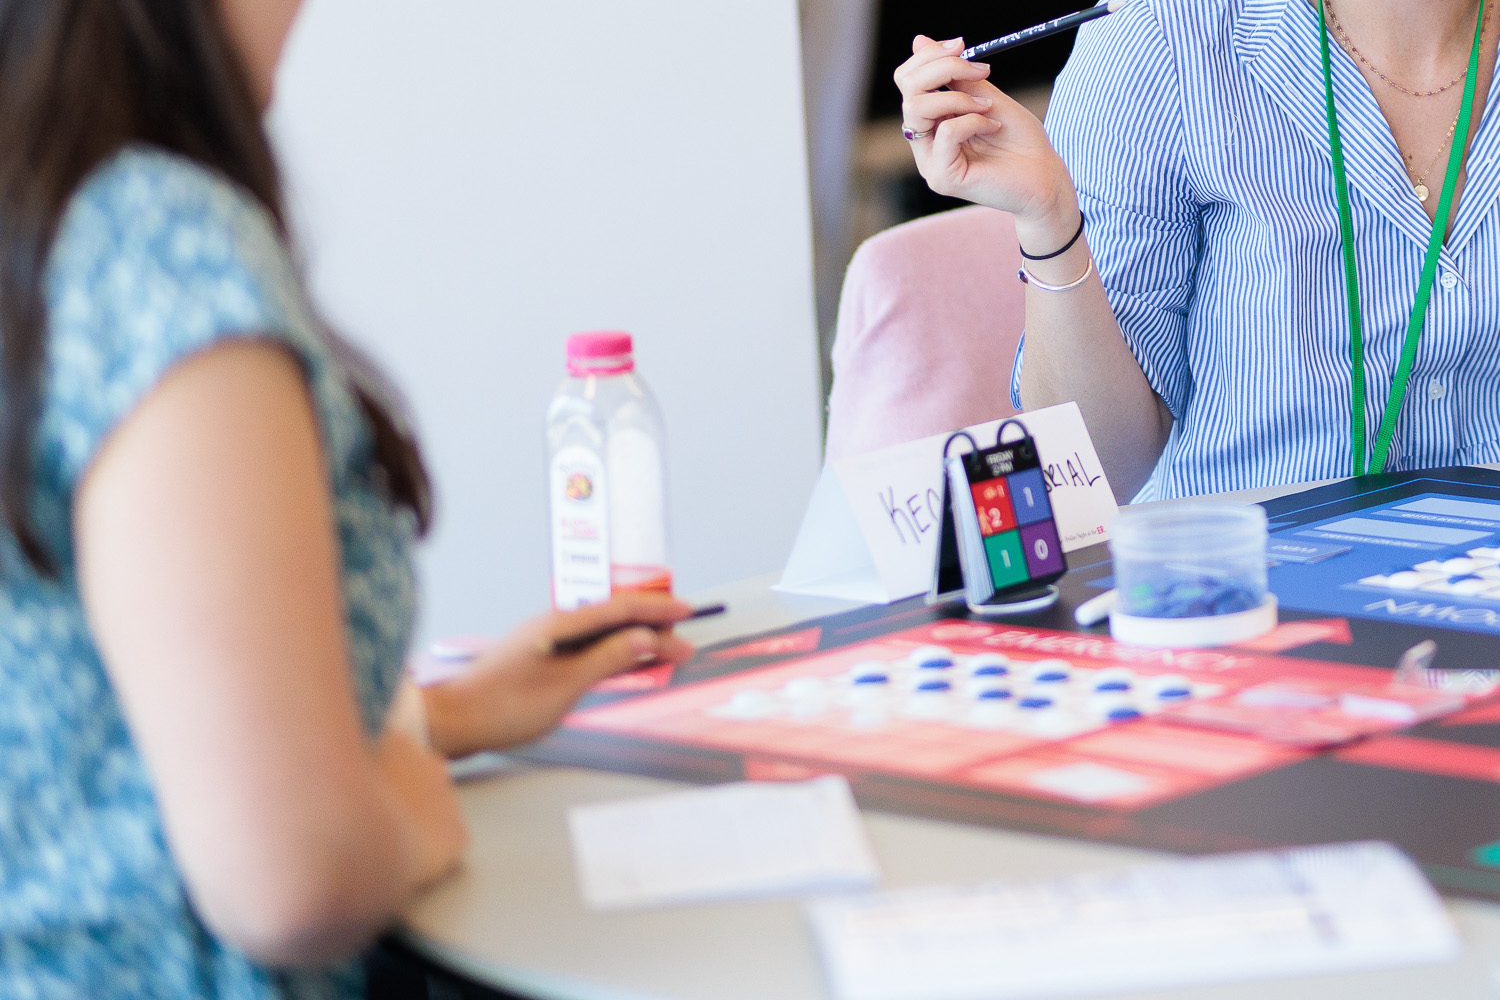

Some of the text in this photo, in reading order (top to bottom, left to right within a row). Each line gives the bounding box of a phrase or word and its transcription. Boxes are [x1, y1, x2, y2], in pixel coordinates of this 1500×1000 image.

[878, 452, 1101, 544] KEC RIAL
[1022, 486, 1034, 508] 1
[988, 507, 1003, 528] 2
[1000, 549, 1011, 568] 1
